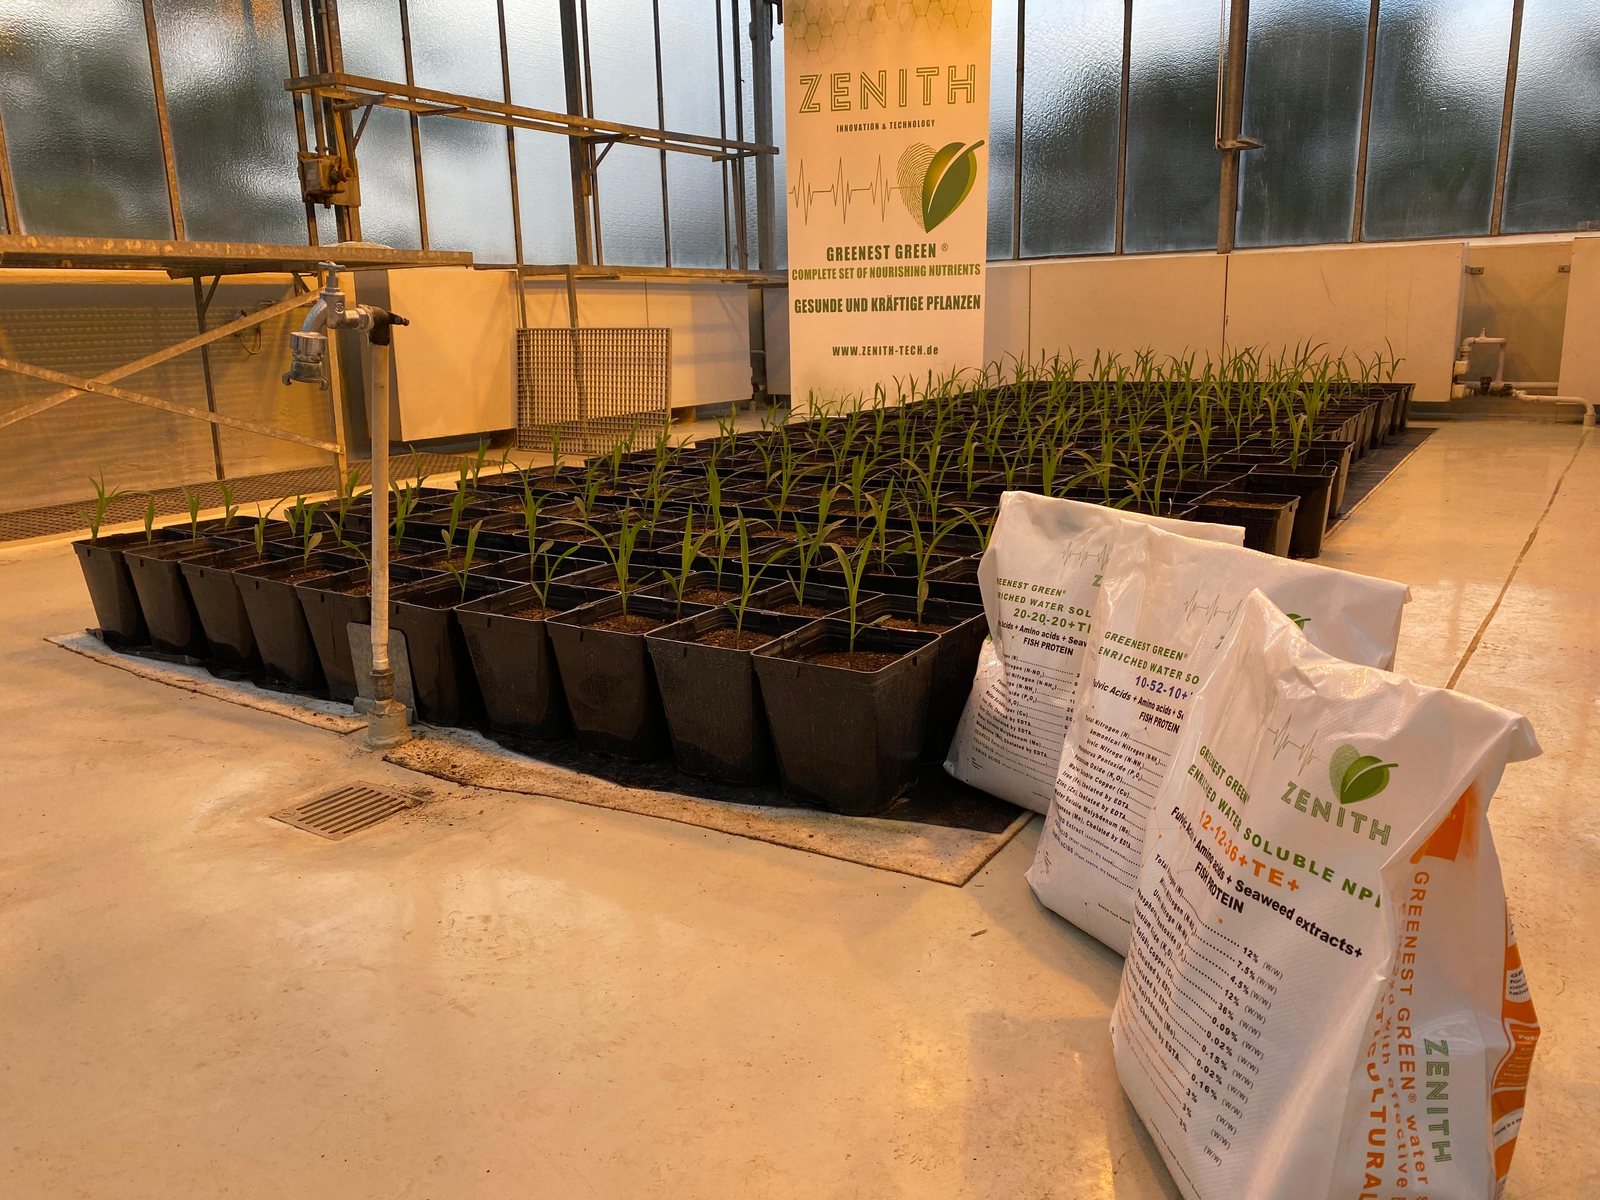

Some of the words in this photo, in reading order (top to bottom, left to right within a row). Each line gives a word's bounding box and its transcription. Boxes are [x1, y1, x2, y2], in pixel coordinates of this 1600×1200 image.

[799, 64, 975, 113] ZENITH
[837, 122, 879, 132] INNOVATION
[890, 119, 935, 130] TECHNOLOGY
[827, 245, 890, 262] GREENEST
[895, 243, 936, 259] GREEN
[792, 268, 836, 280] COMPLETE
[839, 268, 854, 279] SET
[857, 267, 867, 279] OF
[870, 265, 926, 278] NOURISHING
[929, 264, 980, 276] NUTRIENTS
[795, 299, 843, 313] GESUNDE
[846, 298, 868, 312] UND
[872, 295, 923, 311] KRÄFTIGE
[927, 295, 980, 310] PFLANZEN
[833, 345, 938, 356] WWW.ZENITH-TECH.de
[1030, 598, 1064, 612] WATER
[1014, 608, 1092, 633] 20-20-20+T
[1019, 625, 1040, 636] Amino
[1041, 631, 1060, 641] acids
[1104, 631, 1151, 652] GREENEST
[1023, 637, 1039, 647] FISH
[1041, 642, 1074, 655] PROTEIN
[1098, 646, 1148, 671] ENRICHED
[1150, 662, 1183, 680] WATER
[1136, 675, 1194, 700] 10-52-10+
[1109, 686, 1131, 700] Acids
[1138, 697, 1155, 709] Amino
[1156, 705, 1172, 715] acids
[1095, 720, 1119, 734] Nitrogen
[1120, 731, 1130, 739] (N)
[1139, 711, 1152, 724] FISH
[1153, 716, 1180, 734] PROTEIN
[1034, 750, 1047, 758] EDTA
[1100, 745, 1123, 758] Nitroge
[1122, 742, 1145, 756] Nitrogen
[1090, 763, 1105, 774] Oxide
[1097, 755, 1126, 772] Pentoxide
[1200, 746, 1226, 779] GREENEST
[1095, 777, 1115, 790] Copper
[1117, 788, 1130, 799] (Cu)
[1056, 779, 1067, 788] Zinc
[1101, 803, 1109, 812] by
[1110, 809, 1126, 820] EDTA
[1105, 794, 1112, 802] by
[1114, 798, 1129, 809] EDTA
[1083, 806, 1118, 828] Molybdenum
[1281, 780, 1392, 846] ZENITH
[1086, 820, 1110, 837] Chelated
[1111, 834, 1118, 842] by
[1119, 838, 1130, 848] EDTA
[1217, 798, 1243, 832] WATER
[1243, 827, 1335, 883] SOLUBLE
[1195, 862, 1210, 883] FISH
[1206, 876, 1244, 914] PROTEIN
[1195, 839, 1214, 864] Amino
[1213, 860, 1225, 880] acids
[1227, 875, 1232, 884] +
[1234, 878, 1295, 921] Seaweed
[1295, 916, 1363, 959] extracts+
[1400, 871, 1429, 996] GREENEST
[1243, 947, 1258, 963] 12%
[1236, 960, 1256, 981] 7.5%
[1230, 975, 1249, 995] 4.5%
[1224, 989, 1240, 1007] 12%
[1218, 1001, 1234, 1021] 36%
[1211, 1016, 1238, 1042] 0.09%
[1206, 1030, 1233, 1057] 0.02%
[1201, 1045, 1228, 1071] 0.15%
[1397, 1007, 1417, 1103] GREEN®
[1196, 1059, 1223, 1086] 0.02%
[1186, 1088, 1198, 1103] 3%
[1191, 1073, 1218, 1101] 0.16%
[1424, 1038, 1452, 1163] ZENITH
[1406, 1115, 1428, 1185] water
